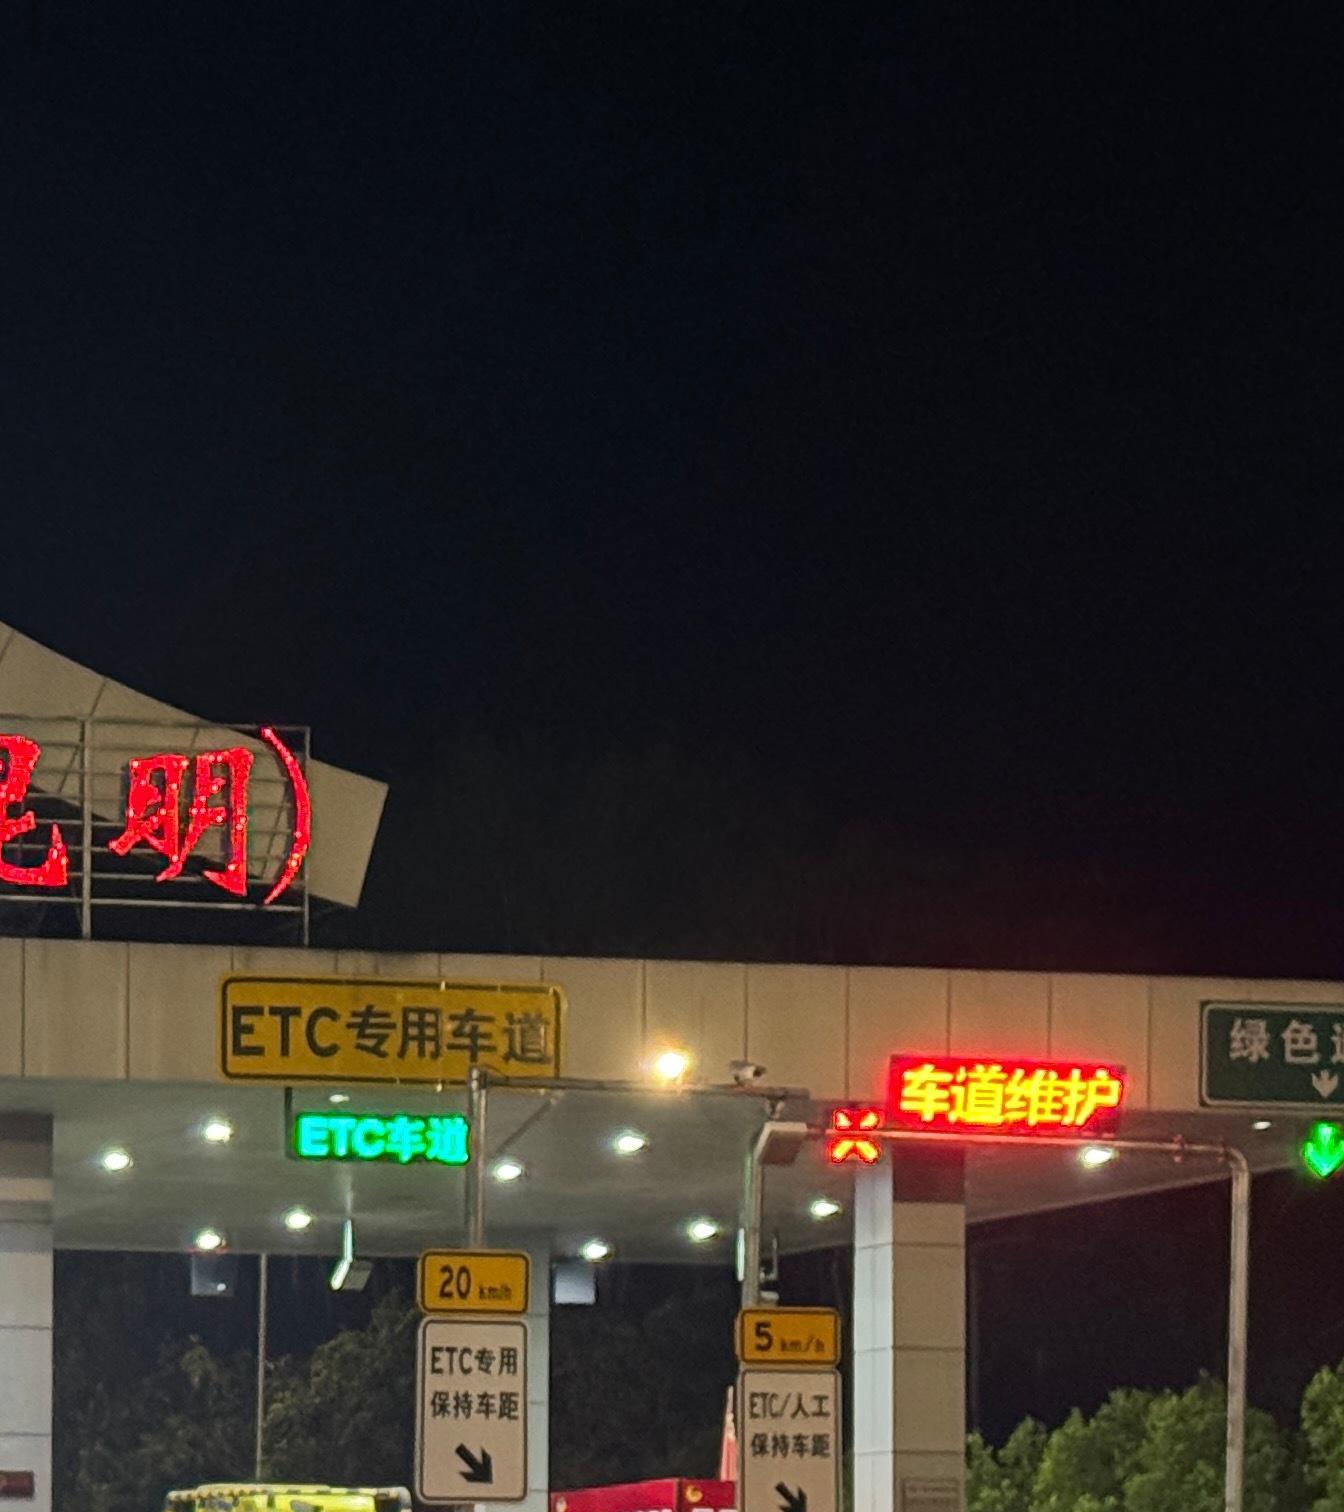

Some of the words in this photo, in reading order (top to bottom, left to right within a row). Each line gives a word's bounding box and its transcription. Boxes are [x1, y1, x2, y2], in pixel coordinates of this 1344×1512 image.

[231, 1004, 552, 1066] ETC专用车道
[898, 1063, 1121, 1127] 车道维护
[297, 1113, 470, 1165] ETC车道
[438, 1264, 471, 1300] 20
[755, 1321, 773, 1352] 5
[780, 1334, 825, 1352] km/h
[430, 1345, 518, 1376] ETC专用
[430, 1390, 520, 1421] 保持车距
[749, 1391, 831, 1419] ETC/人工
[750, 1431, 831, 1459] 保持车距
